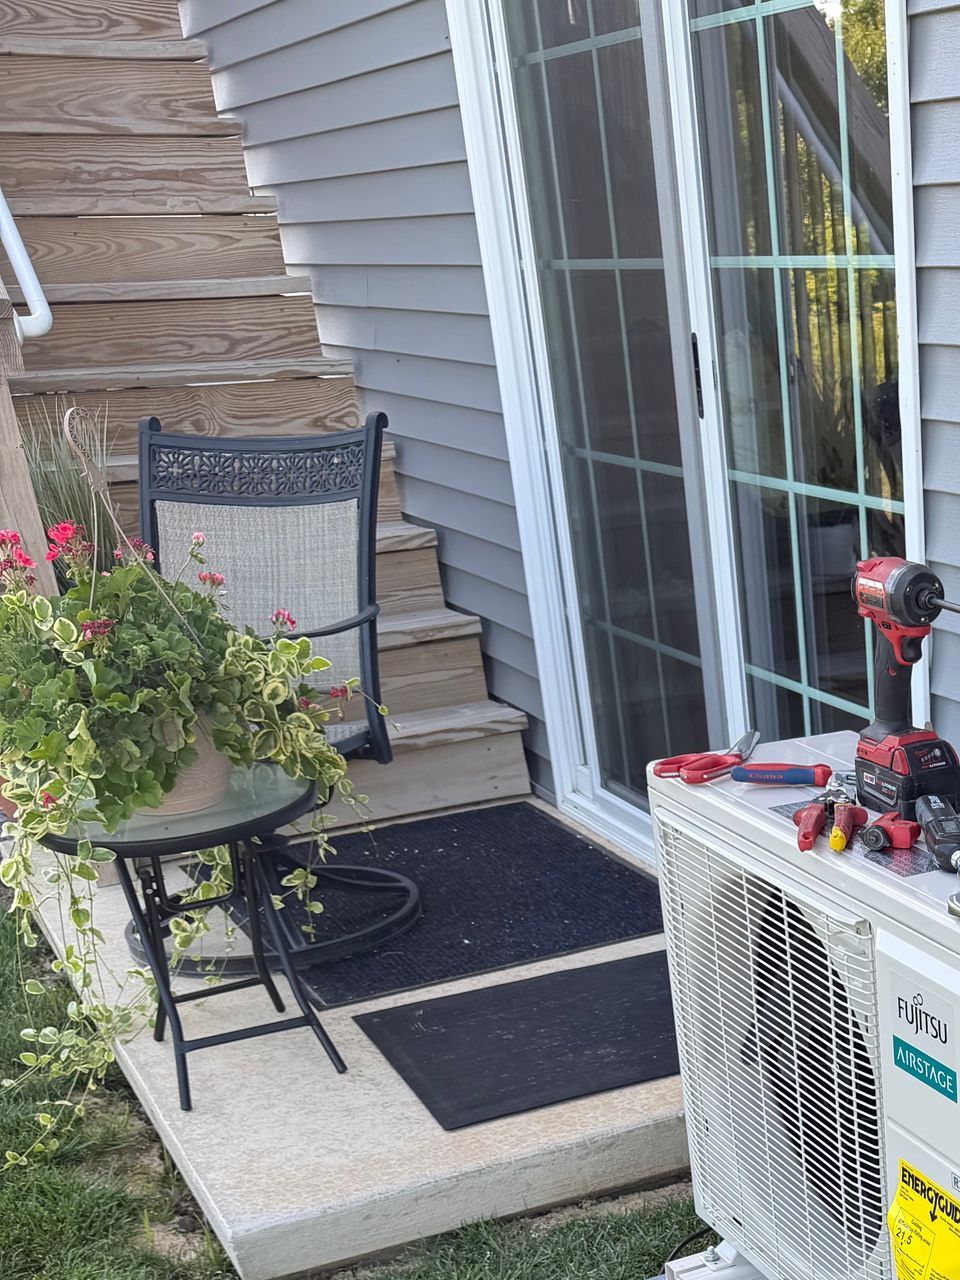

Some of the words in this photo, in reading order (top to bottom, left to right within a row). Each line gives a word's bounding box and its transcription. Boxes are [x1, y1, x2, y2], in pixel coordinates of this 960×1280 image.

[897, 993, 948, 1044] FUJITSU
[896, 1046, 954, 1093] AIRSTAGE
[895, 1227, 913, 1245] 21.5
